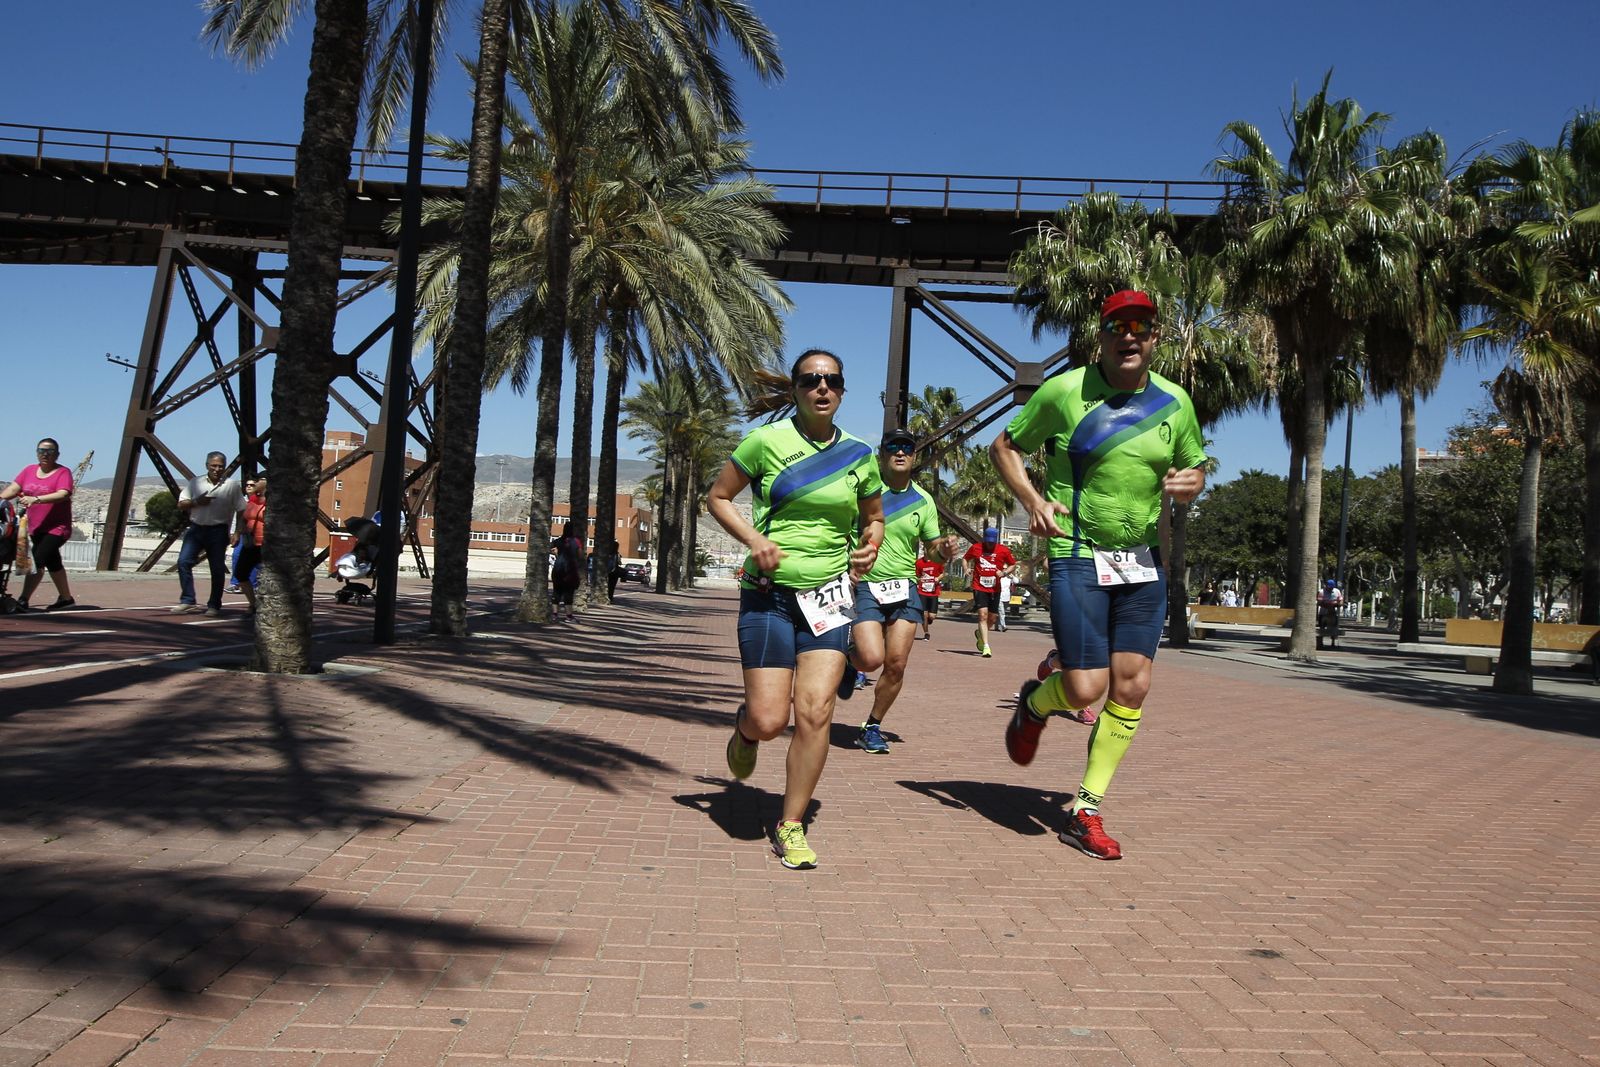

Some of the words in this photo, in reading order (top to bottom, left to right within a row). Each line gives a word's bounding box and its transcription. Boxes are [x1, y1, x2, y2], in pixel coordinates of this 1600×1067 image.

[1113, 549, 1129, 562] 67
[879, 580, 901, 592] 378
[814, 584, 844, 609] 277
